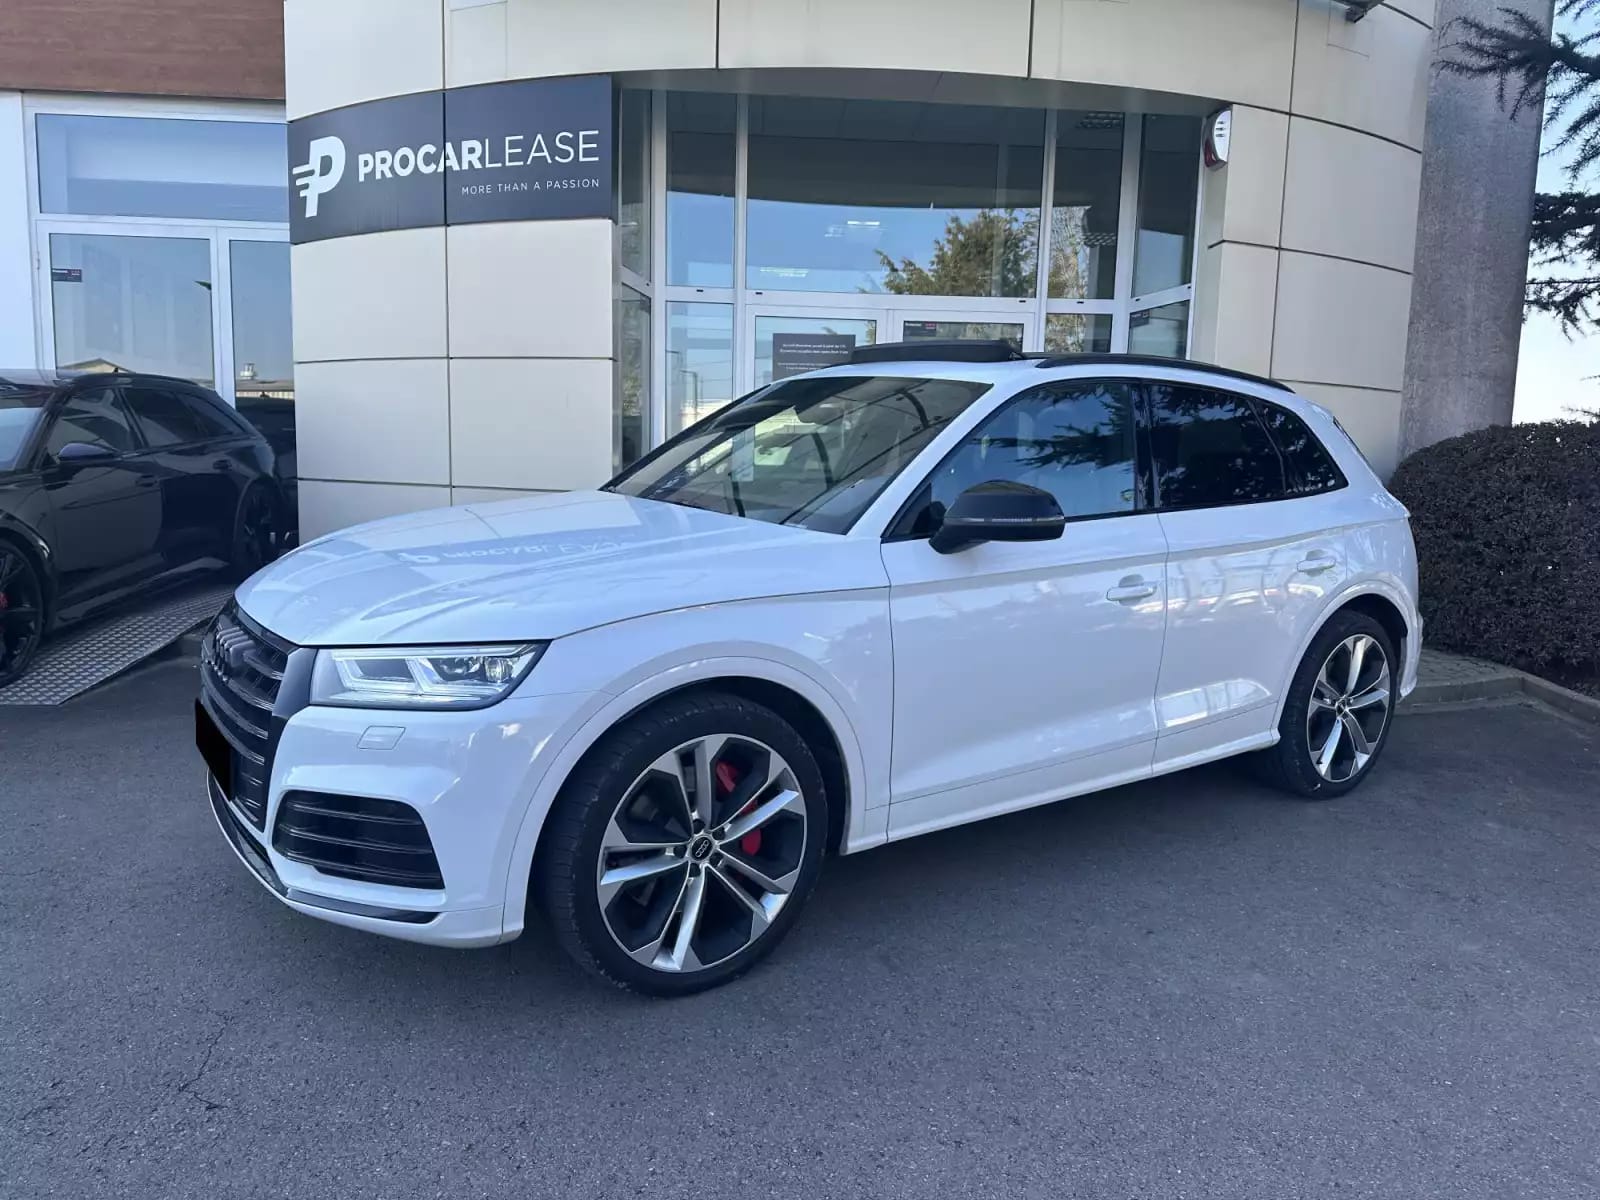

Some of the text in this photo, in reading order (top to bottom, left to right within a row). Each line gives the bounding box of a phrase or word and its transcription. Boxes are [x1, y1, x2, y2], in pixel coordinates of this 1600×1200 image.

[357, 130, 599, 183] PROCARLEASE
[461, 178, 599, 196] MORE THAN A PASSION
